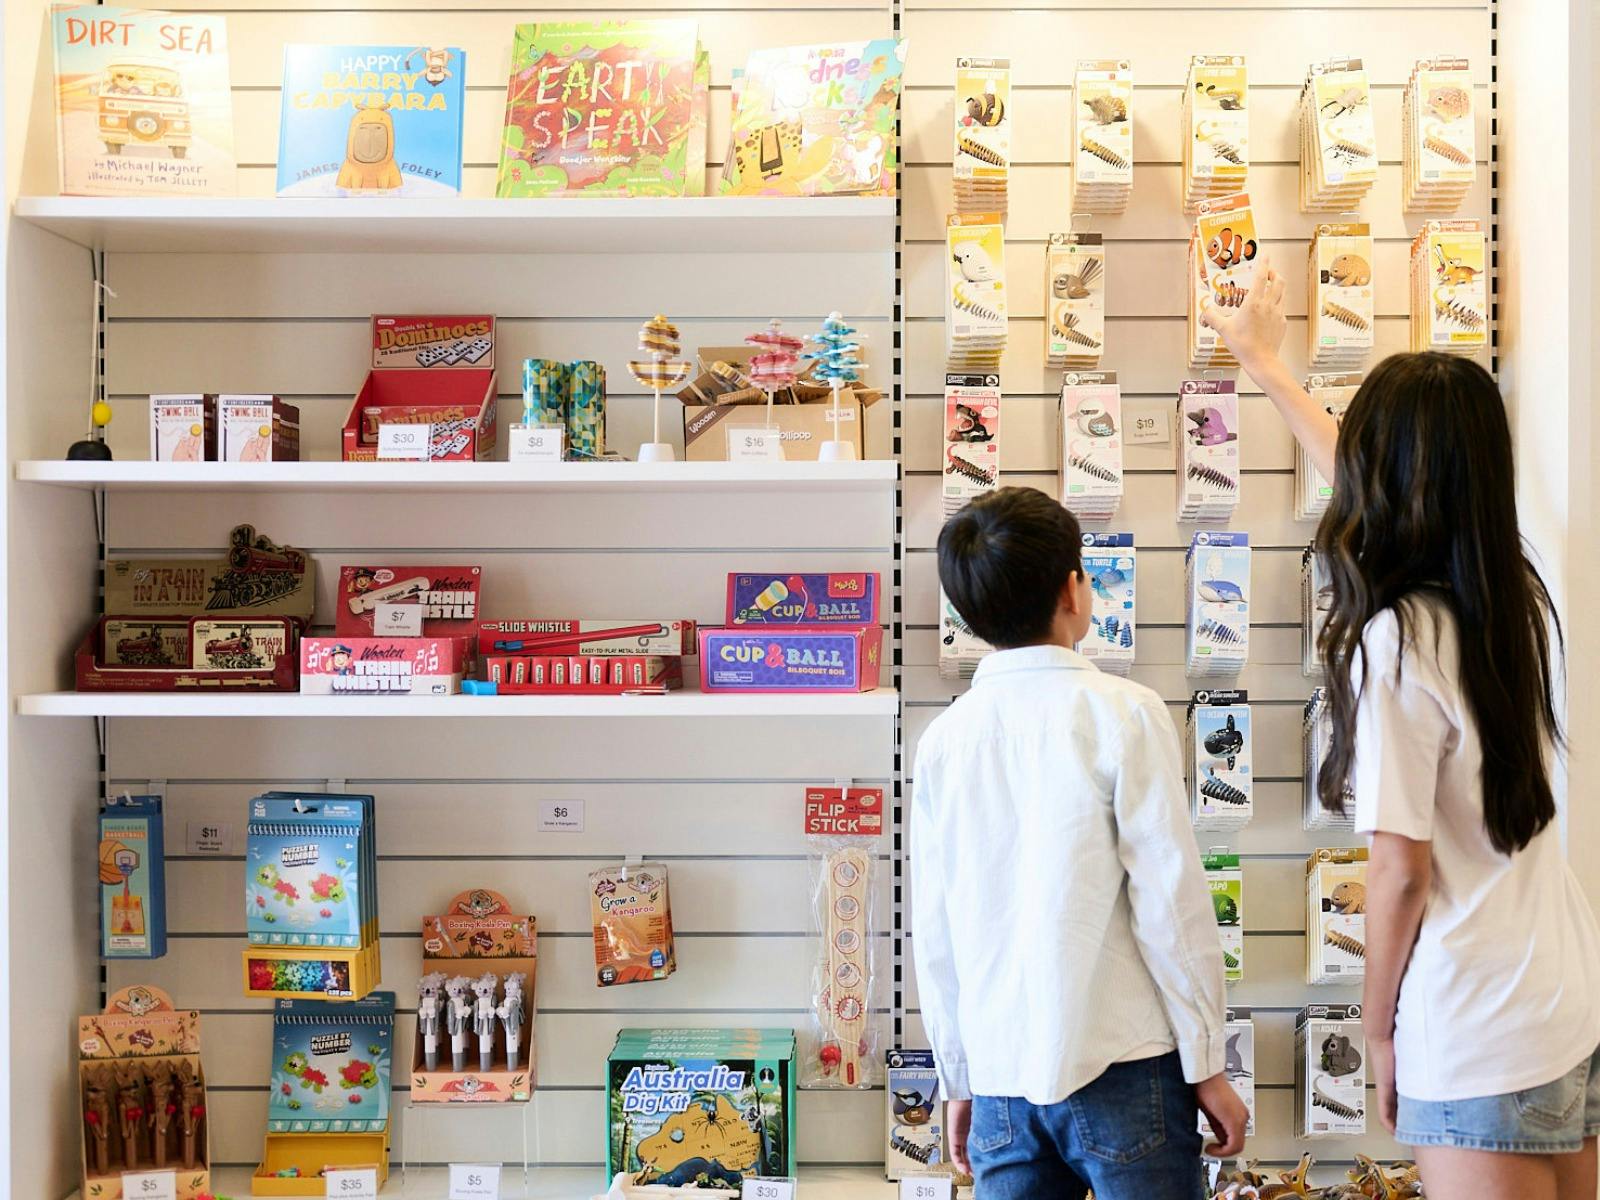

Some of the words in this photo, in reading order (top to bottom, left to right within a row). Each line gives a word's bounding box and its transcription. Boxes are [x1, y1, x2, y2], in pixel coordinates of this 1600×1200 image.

[65, 17, 135, 48] DIRT
[160, 24, 212, 54] SEA
[340, 54, 401, 73] HAPPY
[322, 71, 418, 90] BARRY
[535, 60, 672, 105] EARTH
[292, 90, 447, 111] CAPYBARA
[531, 107, 667, 150] SPEAK
[107, 160, 154, 172] Michael
[158, 161, 204, 176] Wagner
[296, 161, 340, 181] JAMES
[401, 162, 443, 180] FOLEY
[1209, 211, 1248, 228] CLOWNFISH
[378, 320, 489, 350] Dominoes
[161, 406, 181, 417] SWING
[184, 406, 199, 417] BALL
[230, 407, 251, 417] SWING
[253, 407, 268, 417] BALL
[688, 410, 717, 434] Wooden
[1136, 418, 1154, 430] $19
[392, 433, 415, 444] $30
[528, 436, 543, 447] $8
[745, 436, 764, 447] $16
[778, 431, 812, 442] ollipop
[150, 568, 205, 585] TRAIN
[431, 577, 473, 591] Wooden
[134, 585, 152, 601] IN
[158, 585, 169, 601] A
[175, 585, 204, 601] TIN
[418, 590, 476, 604] TRAIN
[771, 605, 803, 617] CUP
[805, 602, 817, 618] &
[818, 602, 861, 616] BALL
[391, 612, 405, 623] $7
[499, 621, 526, 633] SLIDE
[528, 621, 572, 633] WHISTLE
[255, 637, 283, 646] TRAIN
[264, 645, 276, 653] IN
[360, 645, 405, 661] Wooden
[720, 645, 765, 663] CUP
[764, 643, 786, 668] &
[786, 648, 844, 667] BALL
[353, 660, 412, 675] TRAIN
[787, 666, 827, 675] BILBOQUET
[828, 668, 846, 676] BOIS
[333, 675, 412, 691] WHISTLE
[554, 806, 568, 818] $6
[807, 803, 846, 817] FLIP
[810, 818, 859, 833] STICK
[202, 827, 218, 838] $11
[282, 850, 319, 861] NUMBER
[601, 896, 627, 912] Grow
[612, 906, 655, 916] Kangaroo
[448, 919, 475, 930] Boxing
[476, 920, 495, 929] Koala
[496, 919, 511, 929] Pen
[1320, 1024, 1342, 1033] KOALA
[311, 1034, 337, 1043] PUZZLE
[311, 1038, 351, 1050] NUMBER
[622, 1065, 744, 1091] Australia
[899, 1071, 917, 1080] FAIRY
[623, 1092, 659, 1115] Dig
[660, 1092, 691, 1112] Kit
[141, 1179, 157, 1192] $5
[340, 1179, 362, 1191] $35
[467, 1174, 482, 1186] $5
[756, 1186, 778, 1199] $30
[916, 1186, 935, 1198] $16
